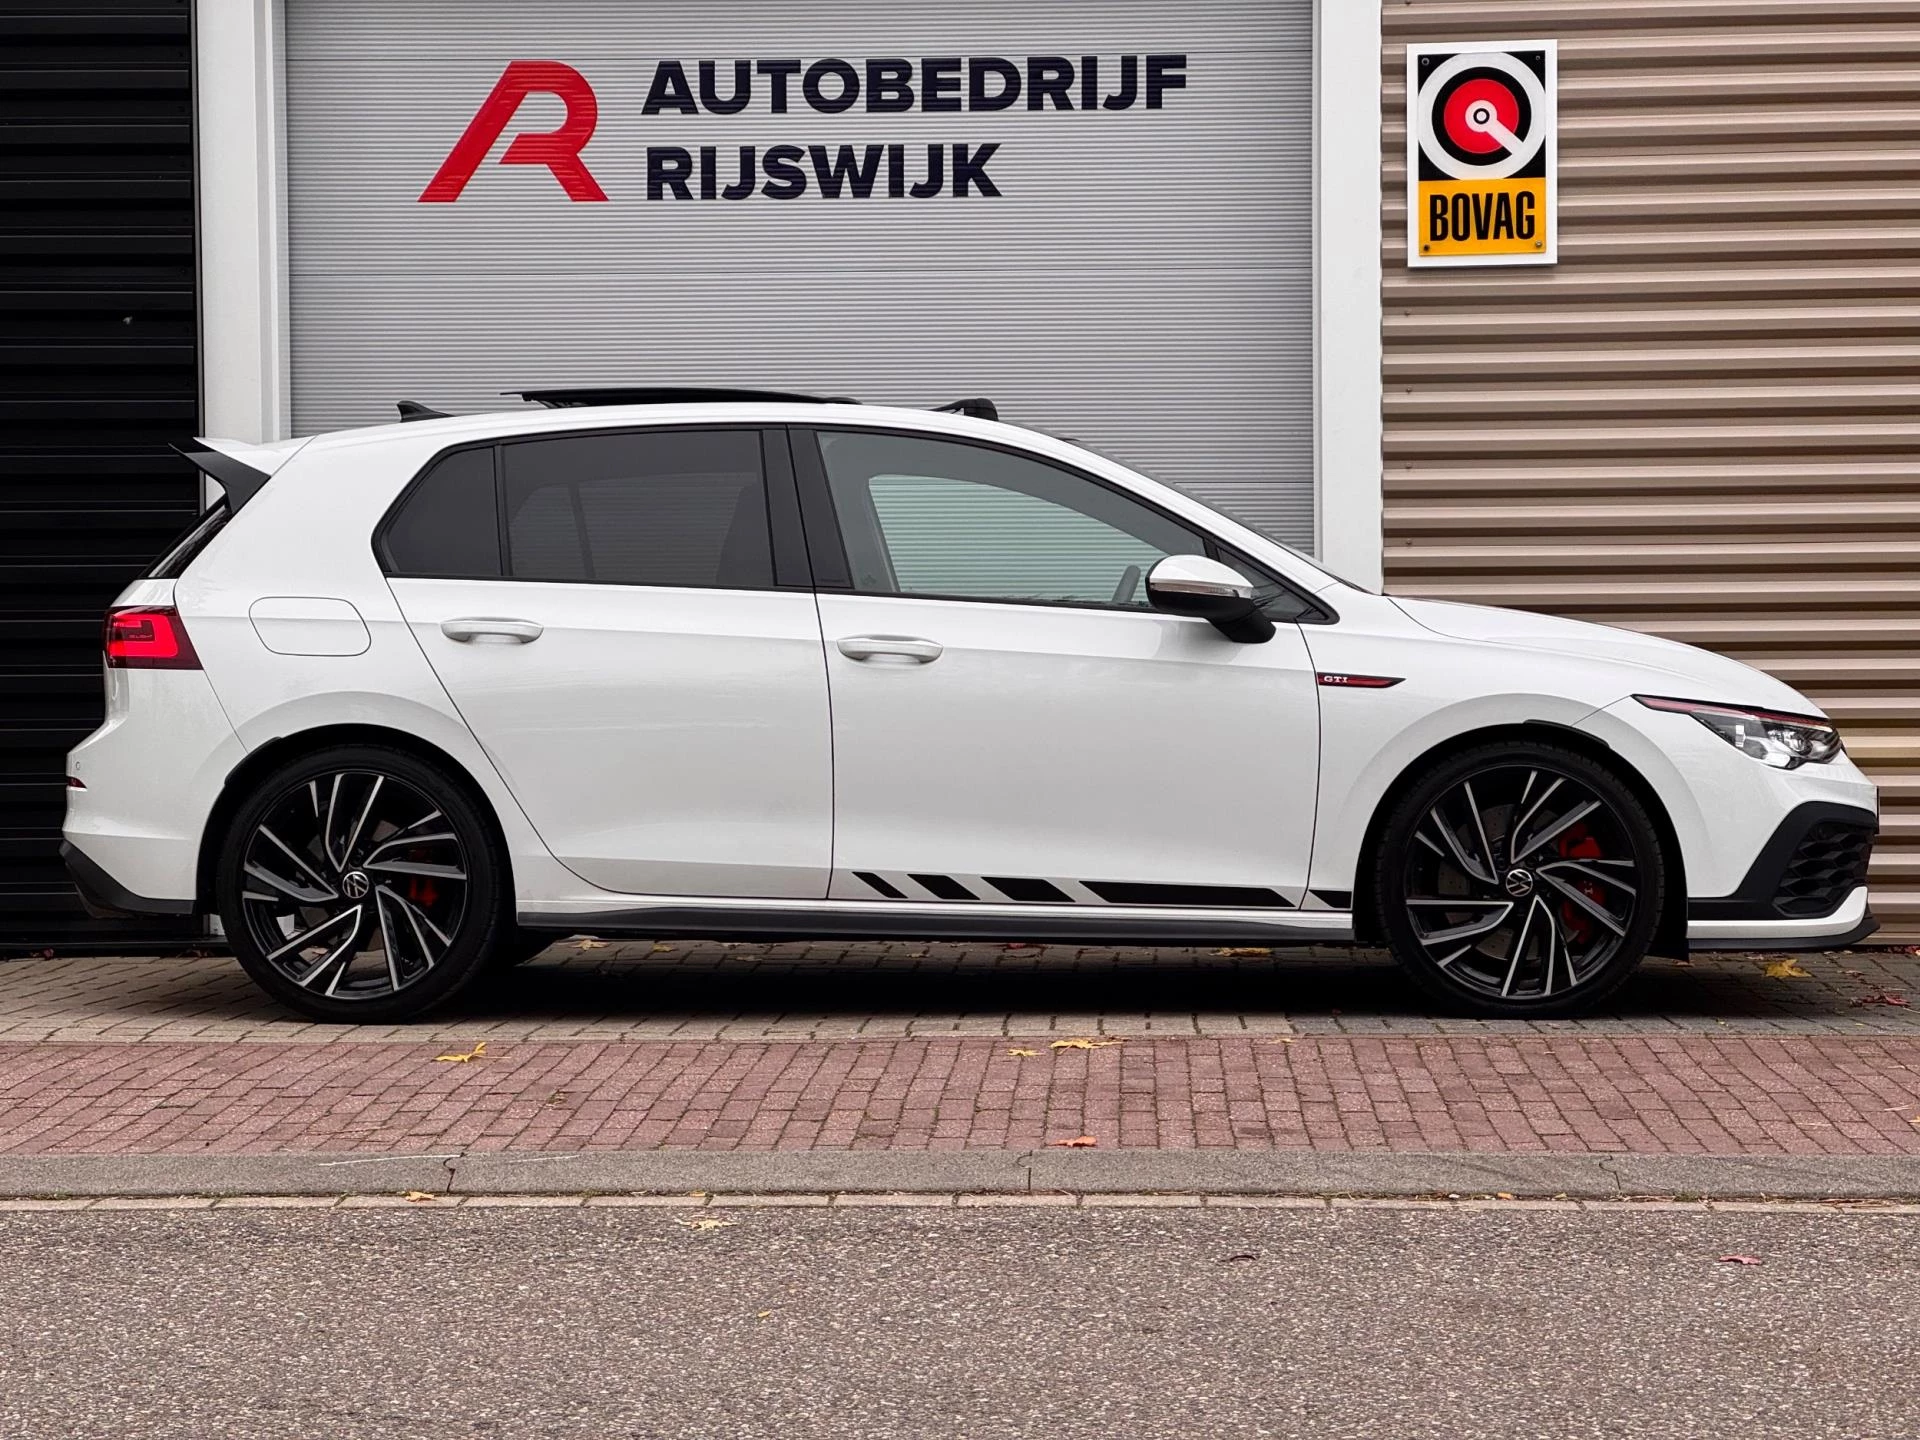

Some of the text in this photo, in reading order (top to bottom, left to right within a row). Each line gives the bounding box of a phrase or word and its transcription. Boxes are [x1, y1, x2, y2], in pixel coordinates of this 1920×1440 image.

[641, 54, 1188, 116] AUTOBEDRIJF
[646, 143, 1002, 201] RIJSWIJK
[1429, 191, 1535, 242] BOVAG
[1323, 675, 1348, 683] GTI
